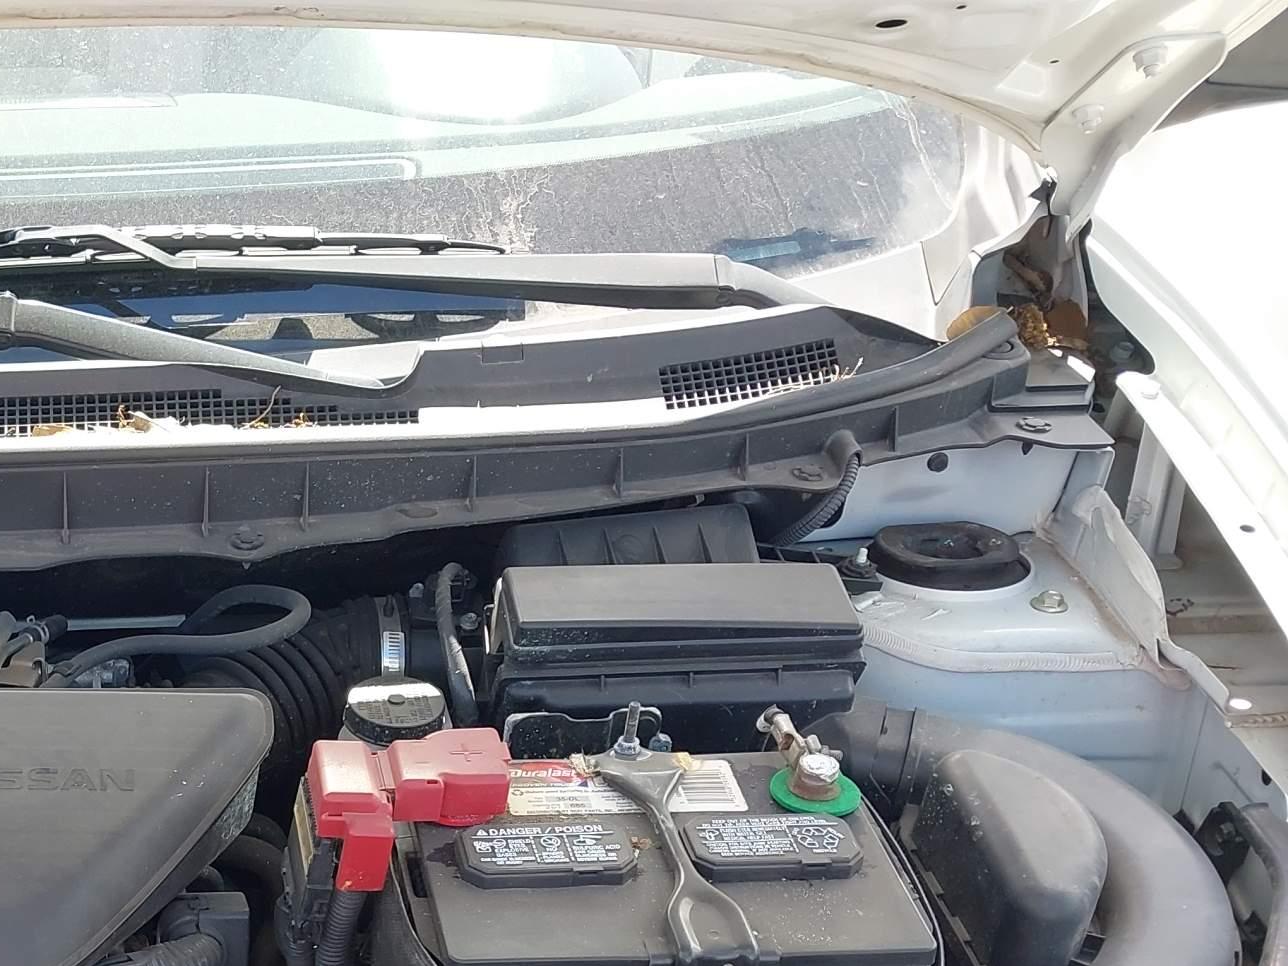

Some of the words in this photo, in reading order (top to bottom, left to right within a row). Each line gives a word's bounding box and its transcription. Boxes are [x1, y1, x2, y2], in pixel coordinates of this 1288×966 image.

[510, 768, 577, 778] Duralast
[488, 827, 542, 836] DANGER
[554, 824, 602, 834] POISON
